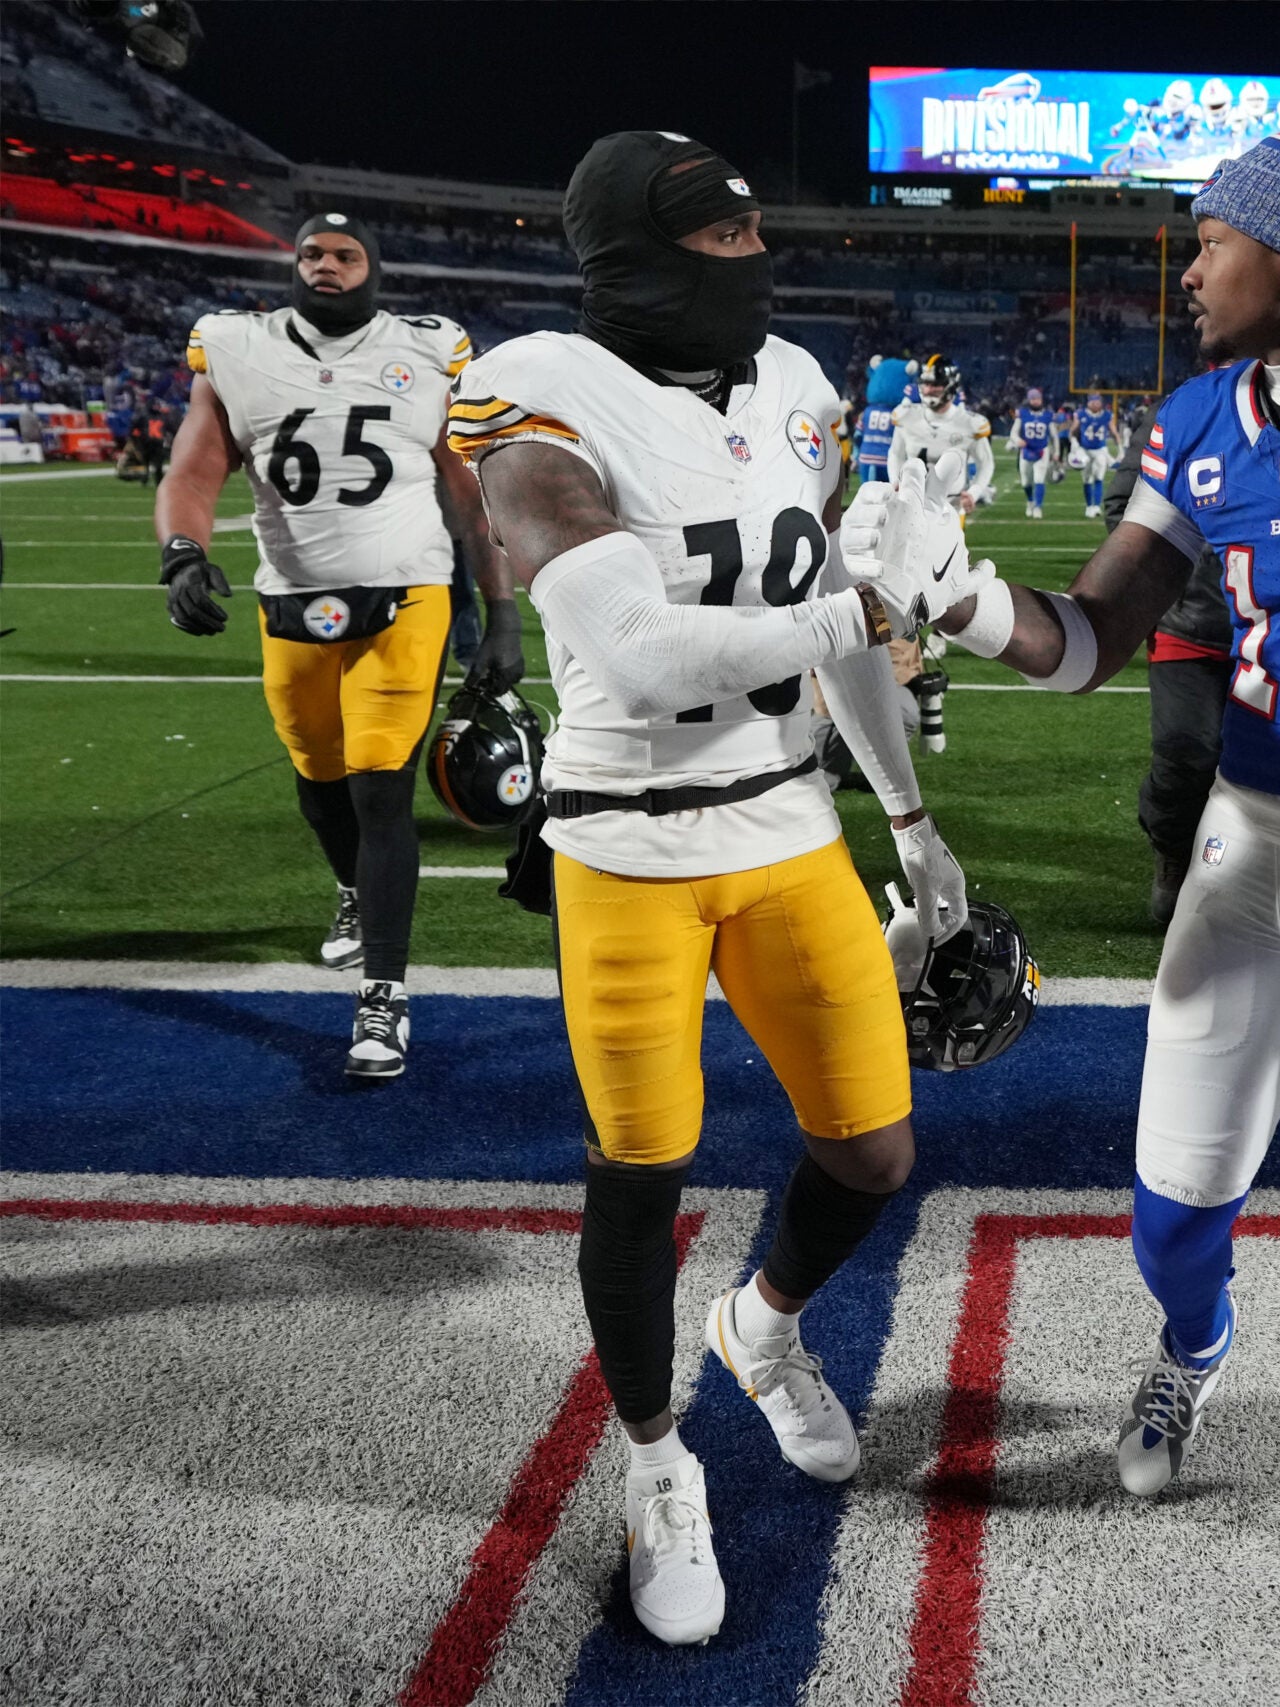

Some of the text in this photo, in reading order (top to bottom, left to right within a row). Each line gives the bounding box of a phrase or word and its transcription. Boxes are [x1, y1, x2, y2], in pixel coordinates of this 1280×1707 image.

[922, 97, 1093, 164] DIVISIONAL
[893, 186, 952, 201] IMAGINE
[983, 189, 1027, 203] HUNT
[1024, 422, 1047, 440] 69
[1084, 423, 1105, 441] 44
[268, 405, 393, 506] 65
[1188, 457, 1221, 497] C
[656, 1477, 673, 1494] 18
